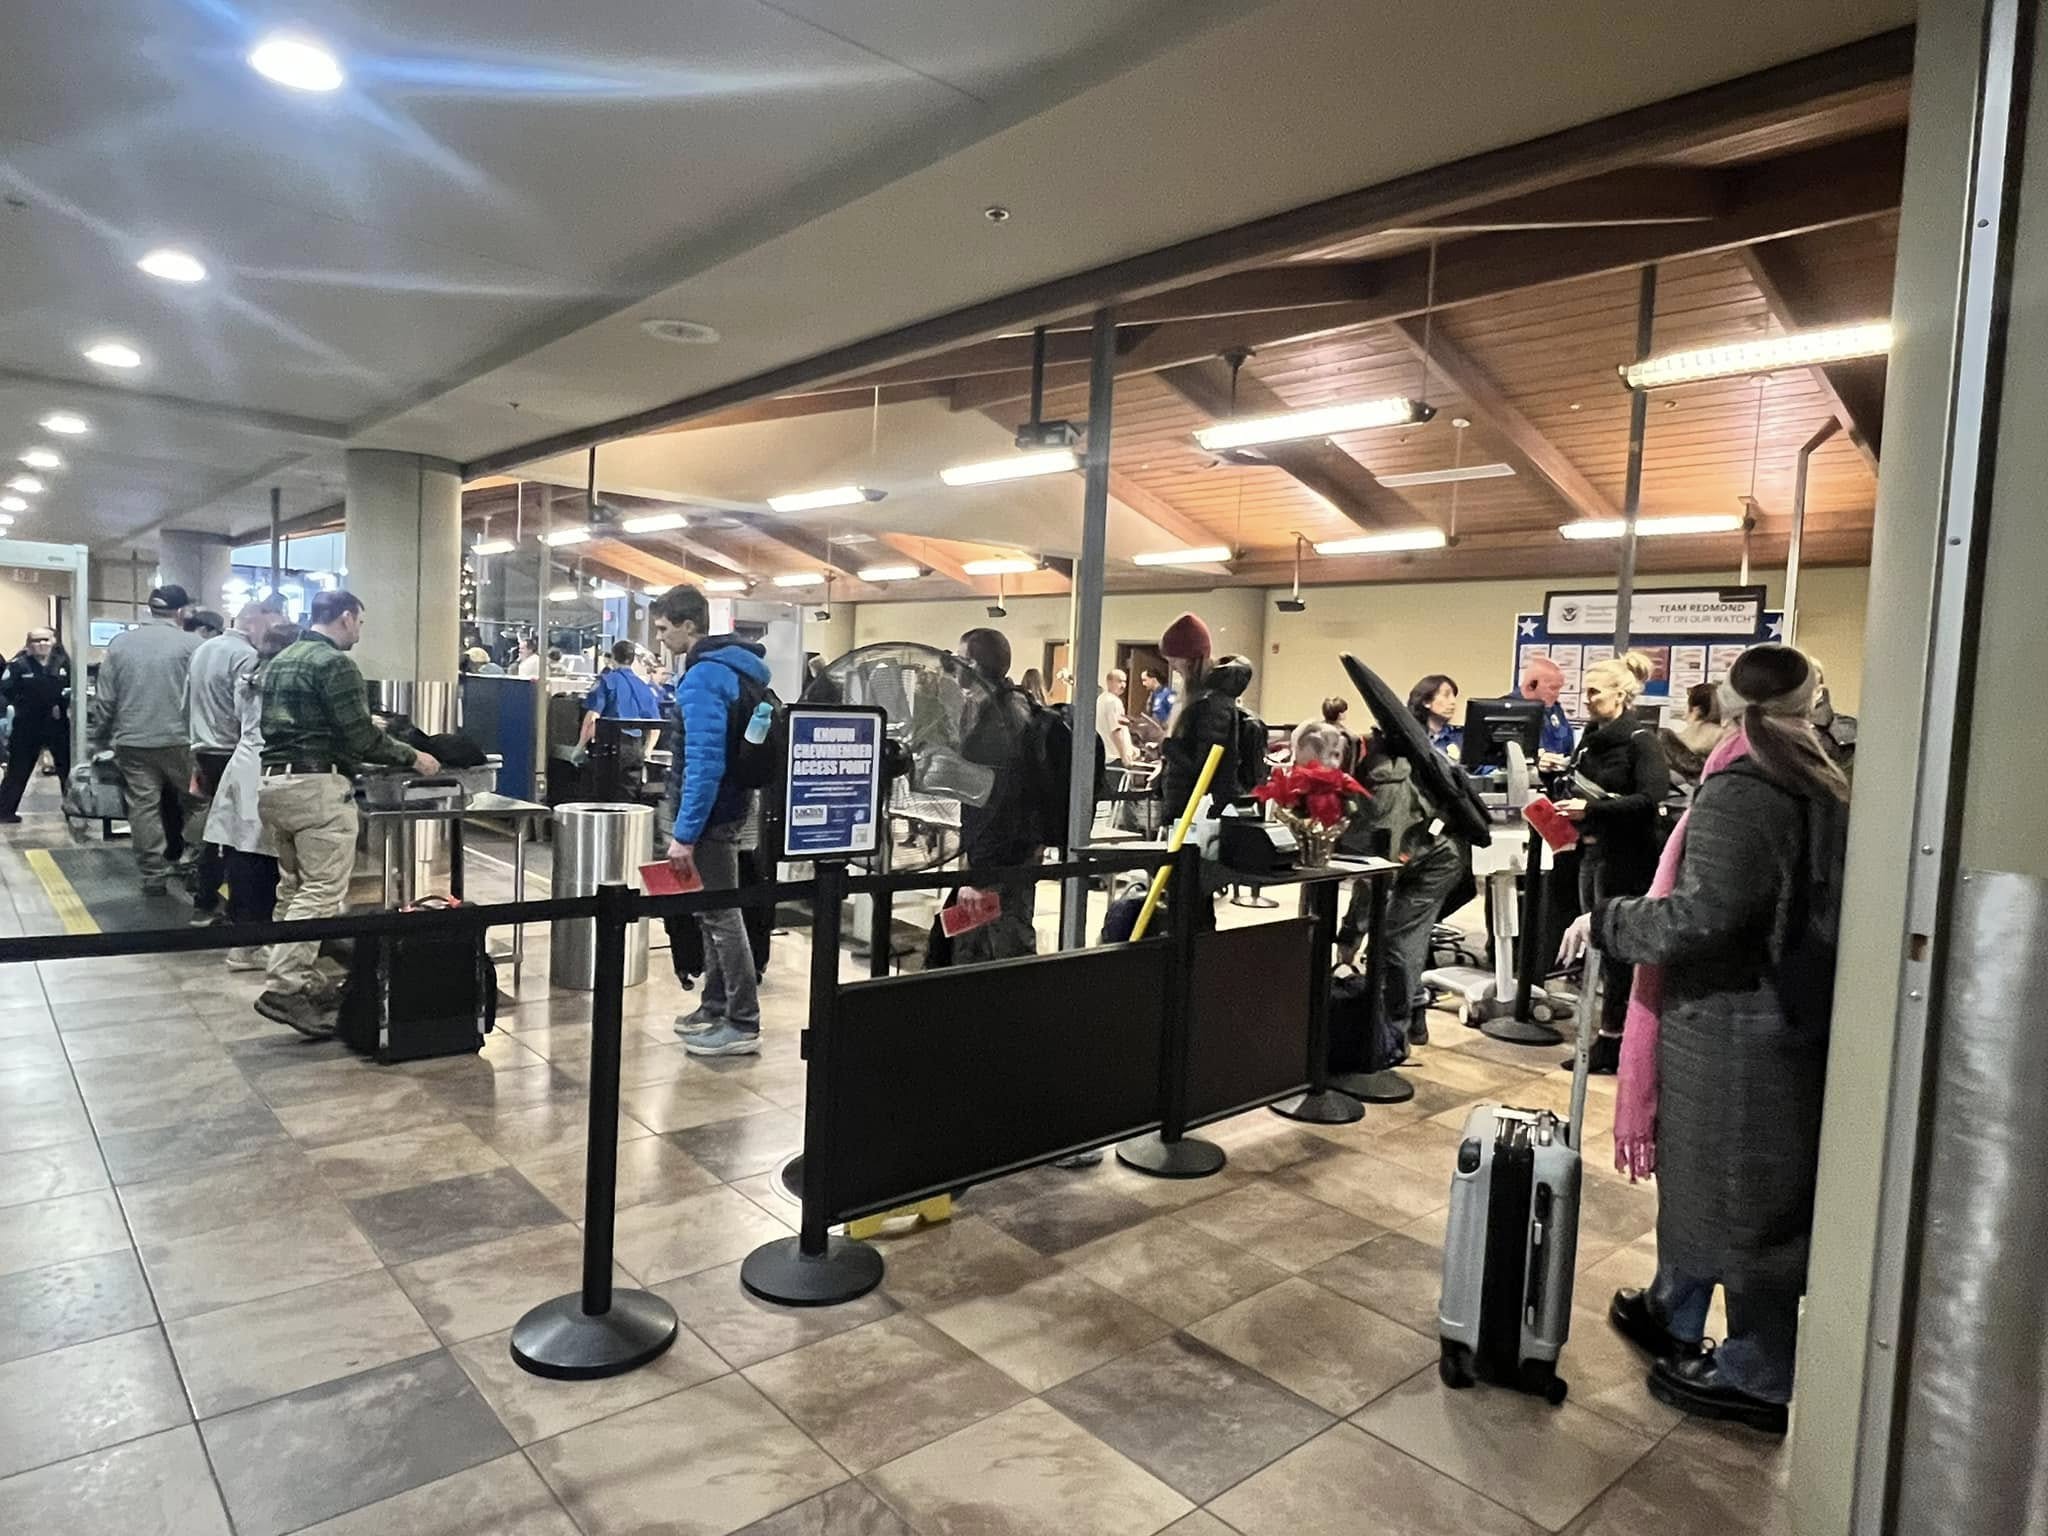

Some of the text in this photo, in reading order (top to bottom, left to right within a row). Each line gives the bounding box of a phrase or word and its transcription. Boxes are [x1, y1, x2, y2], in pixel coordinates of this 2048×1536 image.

[1660, 603, 1746, 613] TEAM REDMOND
[793, 760, 872, 776] ACCESS POINT
